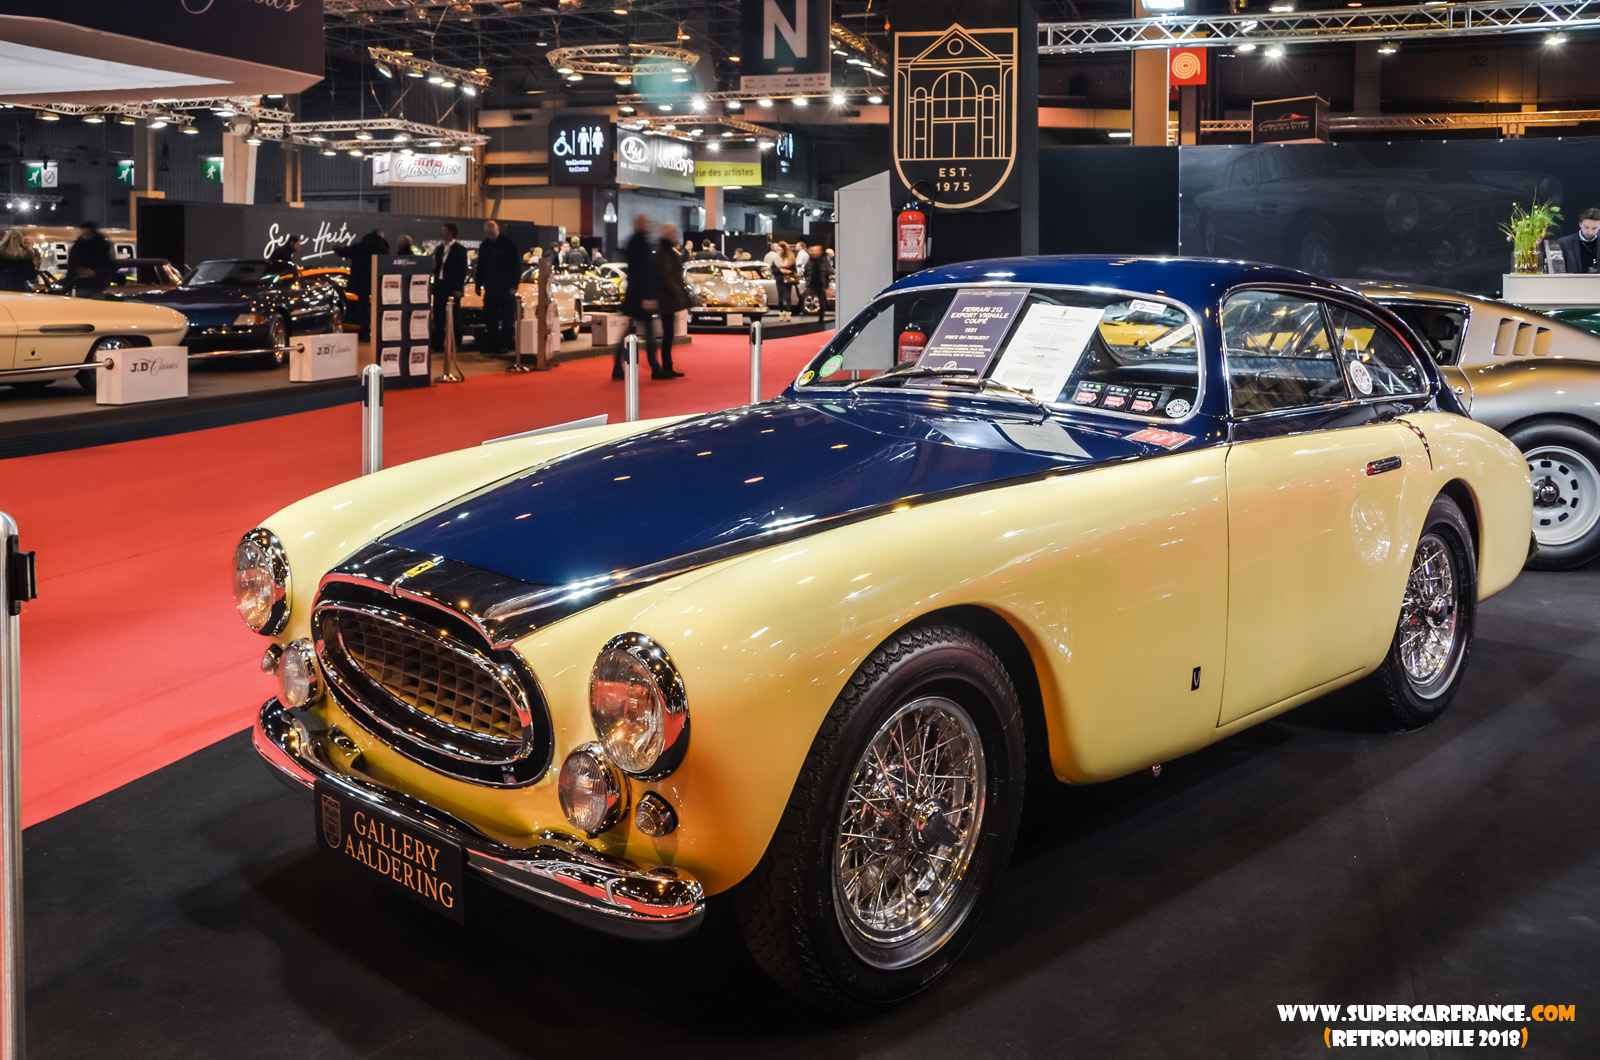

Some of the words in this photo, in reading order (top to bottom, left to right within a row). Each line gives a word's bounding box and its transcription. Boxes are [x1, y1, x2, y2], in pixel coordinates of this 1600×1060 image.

[763, 0, 808, 59] N
[1470, 55, 1488, 67] 32
[396, 160, 461, 181] Classiques
[708, 167, 721, 177] des
[723, 167, 754, 177] artistes
[939, 167, 972, 178] EST.
[936, 181, 971, 192] 1975
[317, 346, 330, 356] J.D
[130, 361, 149, 373] J.D
[149, 358, 180, 376] Classics
[353, 811, 440, 872] GALLERY
[344, 833, 454, 909] AALDERING
